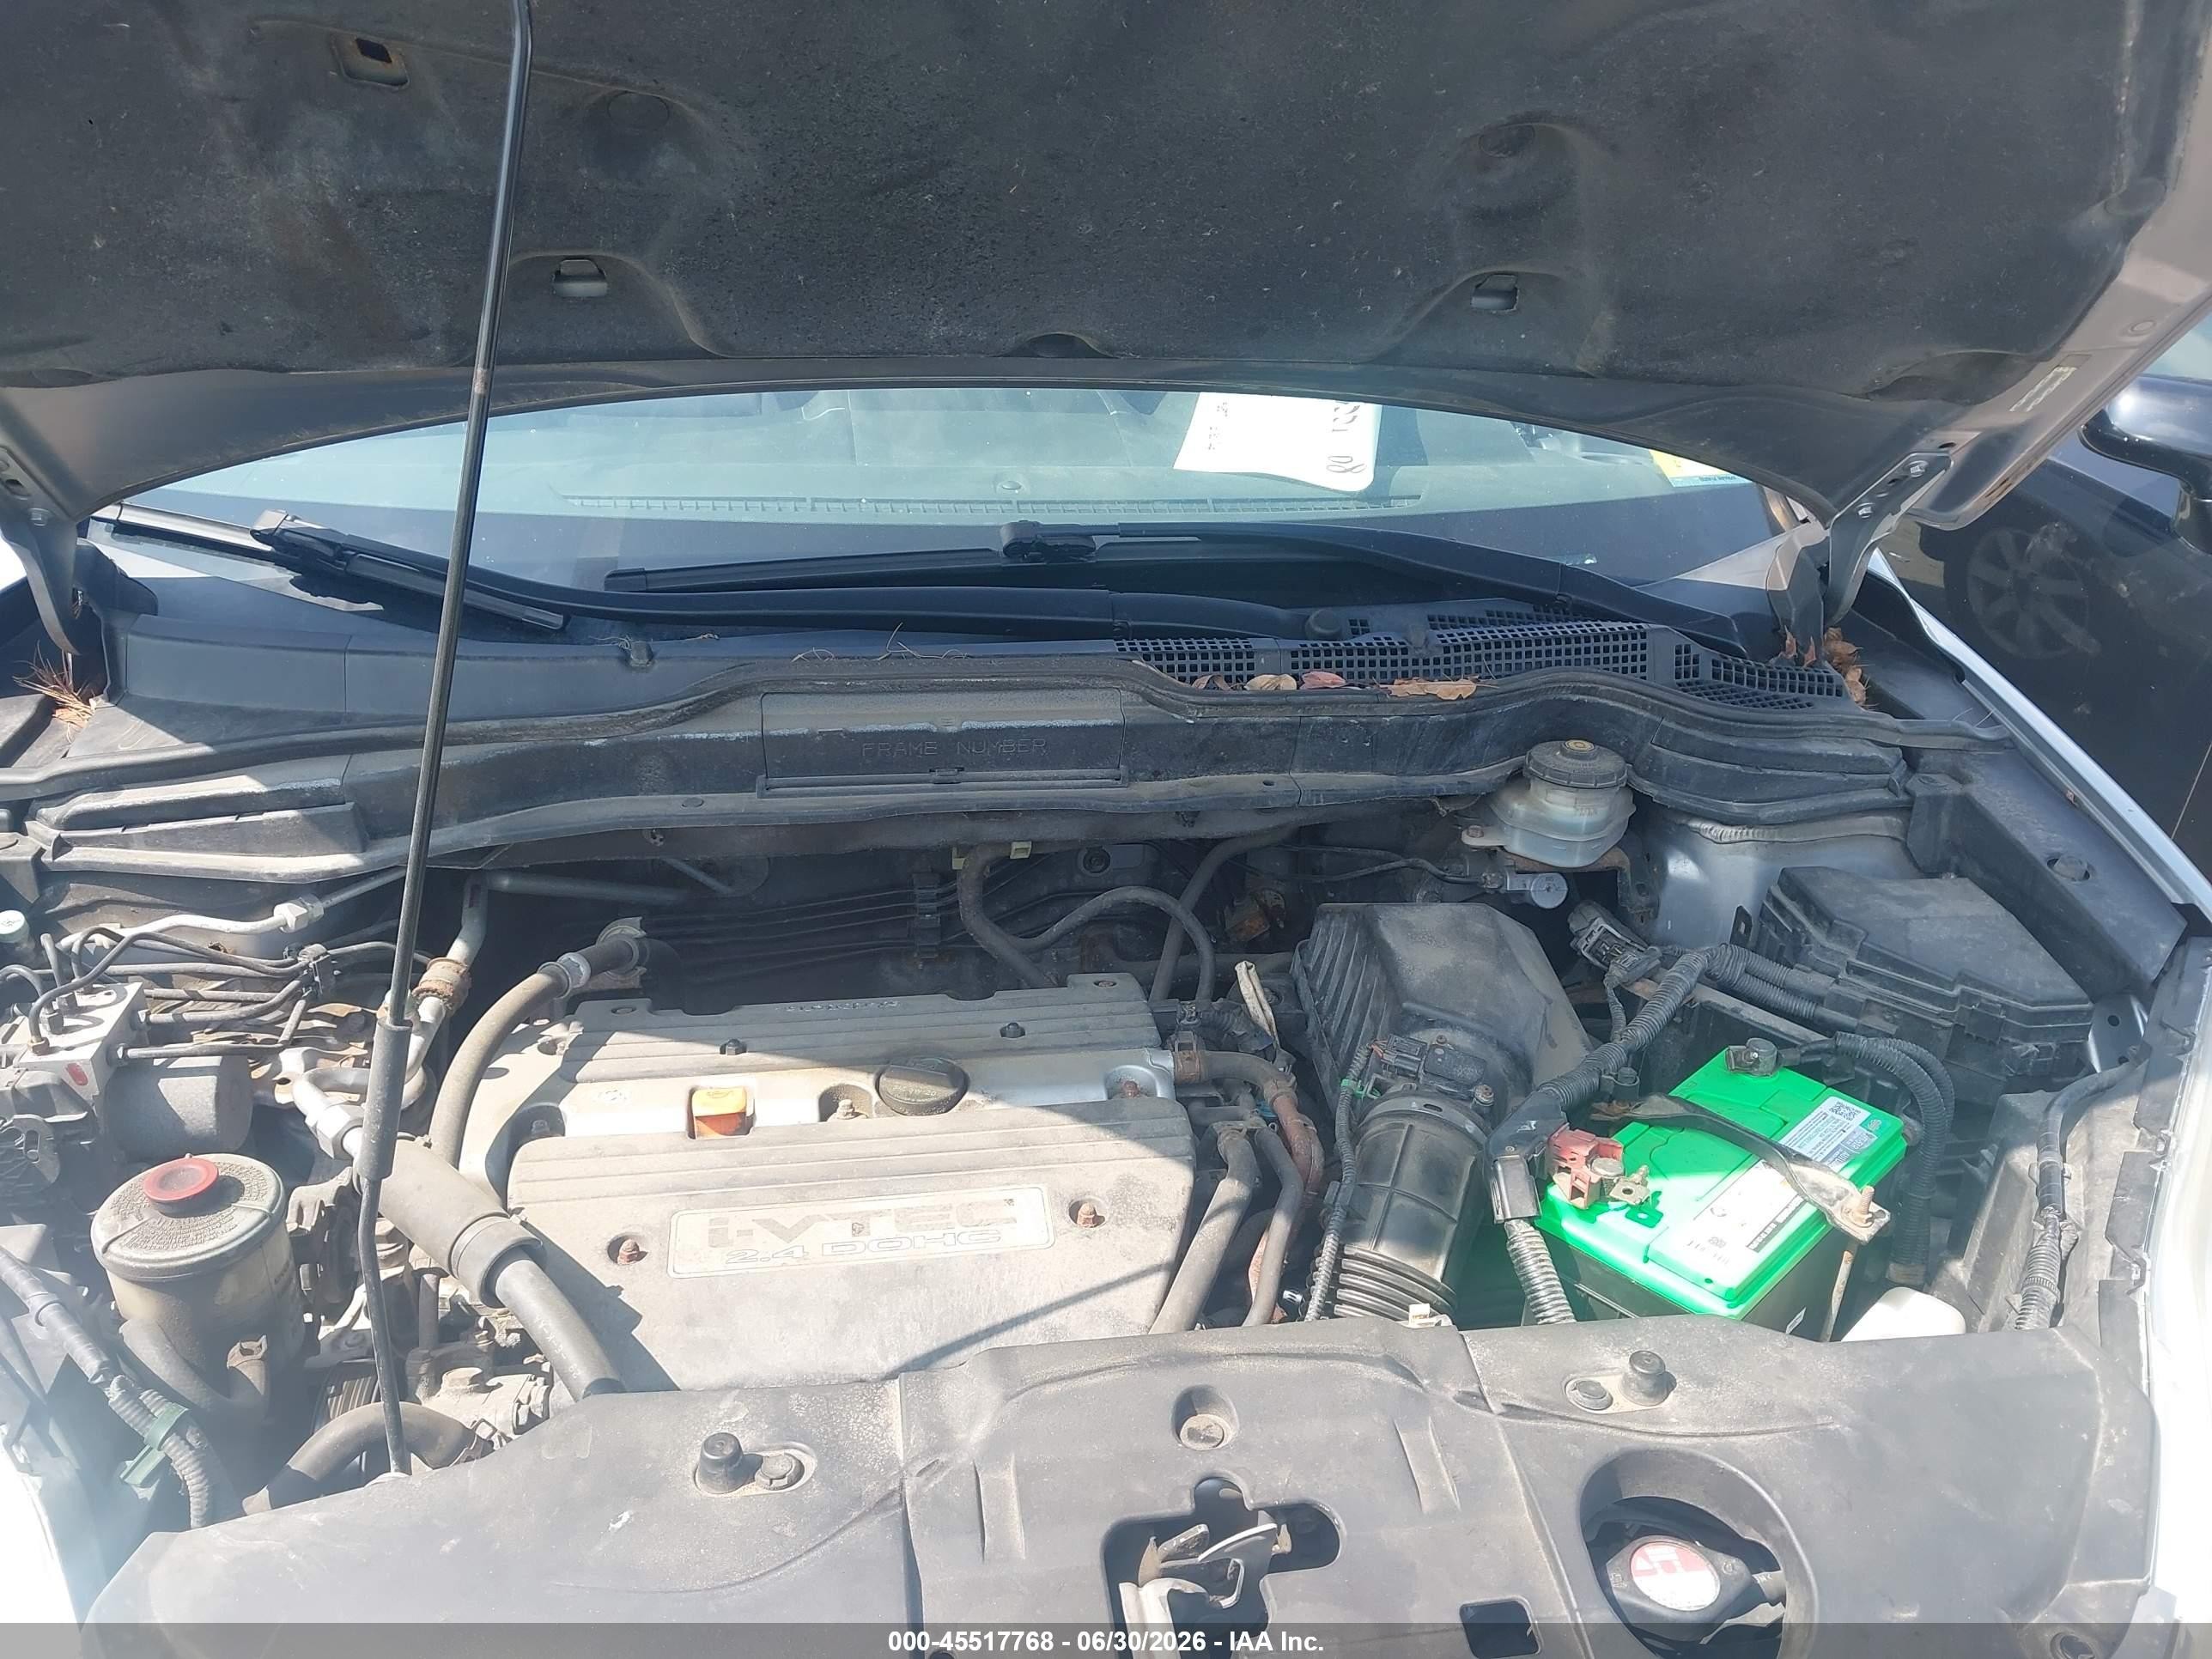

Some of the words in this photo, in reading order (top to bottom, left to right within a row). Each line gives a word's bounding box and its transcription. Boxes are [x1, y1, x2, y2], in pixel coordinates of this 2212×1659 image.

[861, 741, 938, 757] FRAME
[957, 738, 1047, 757] NUMBER
[725, 1244, 808, 1265] 2.4
[821, 1229, 1001, 1257] DOHC
